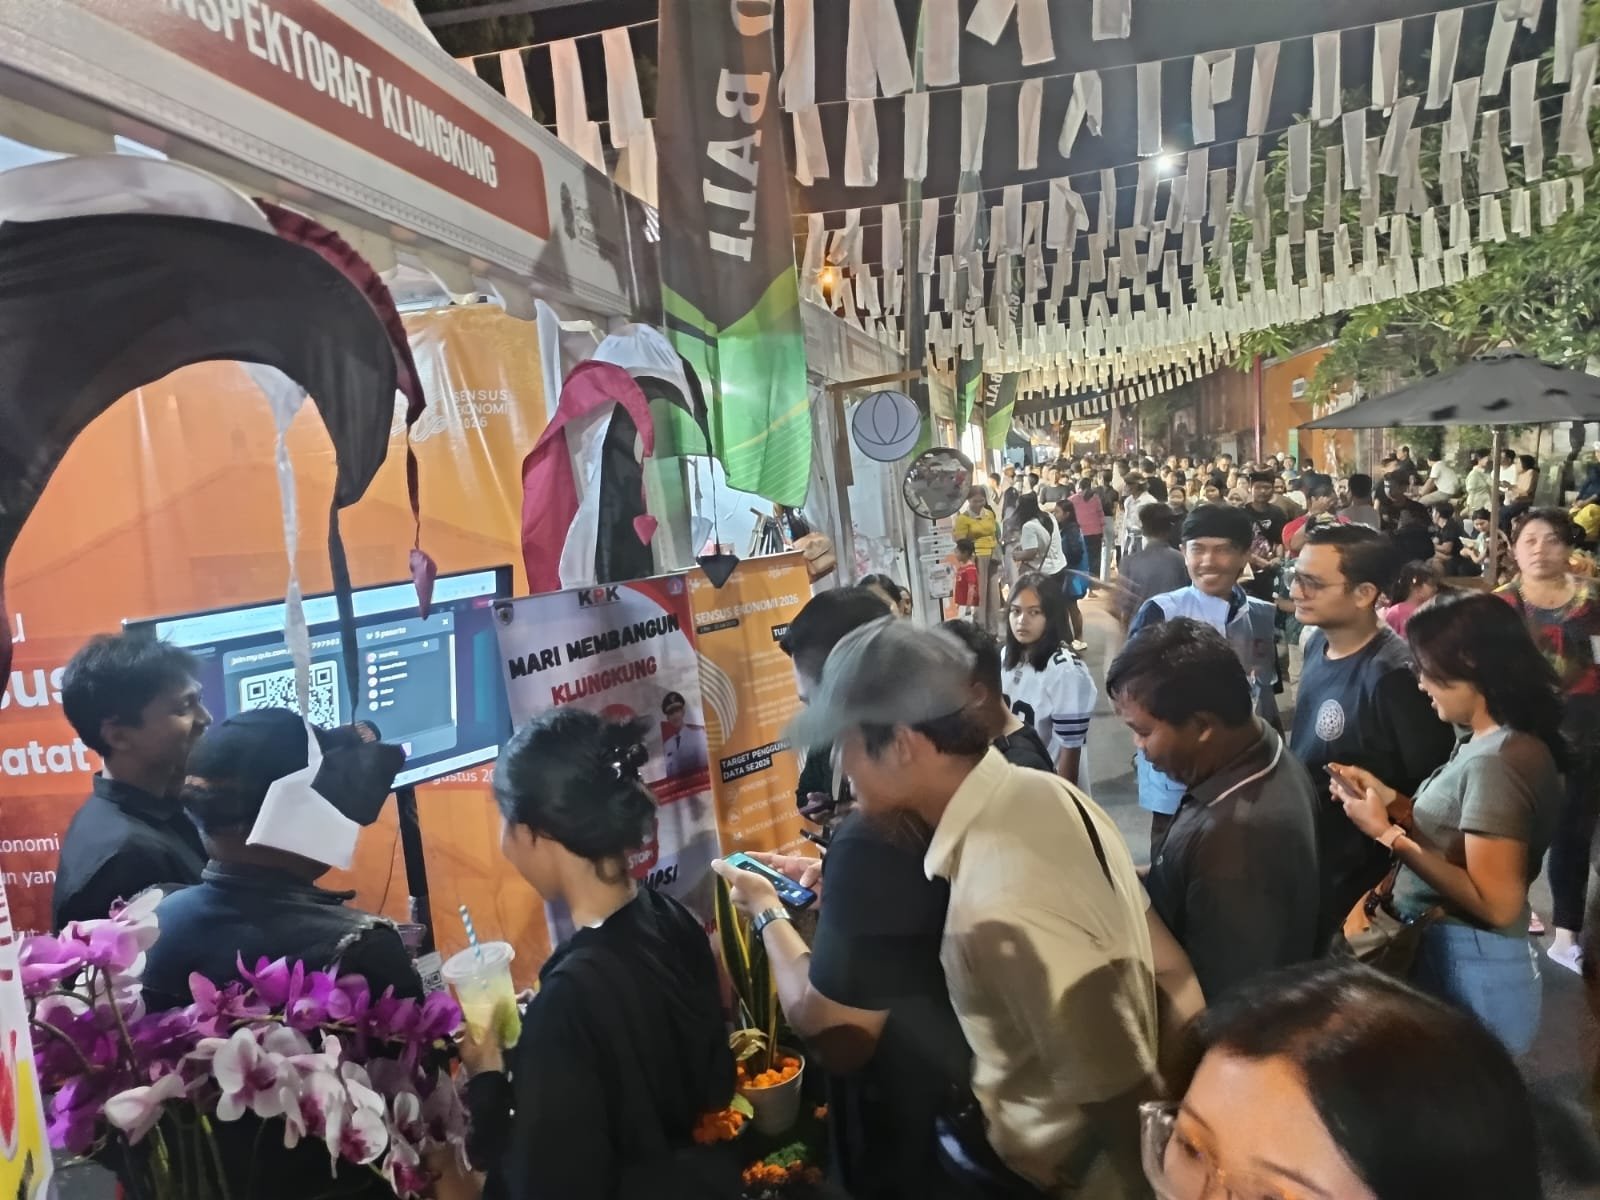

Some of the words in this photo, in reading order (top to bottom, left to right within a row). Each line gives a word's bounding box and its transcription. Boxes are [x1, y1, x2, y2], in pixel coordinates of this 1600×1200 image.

[377, 77, 499, 189] KLUNGKUNG
[578, 585, 620, 607] KPK
[695, 607, 733, 625] SENSUS
[779, 593, 799, 608] 2026
[508, 645, 562, 680] MARI
[566, 612, 680, 663] MEMBANGUN
[551, 655, 657, 706] KLUNGKUNG
[0, 737, 91, 777] atat
[721, 753, 751, 770] TARGET
[751, 738, 792, 760] PENGGUN
[722, 767, 745, 781] DATA
[0, 832, 60, 853] onomi
[641, 863, 678, 890] UPSI
